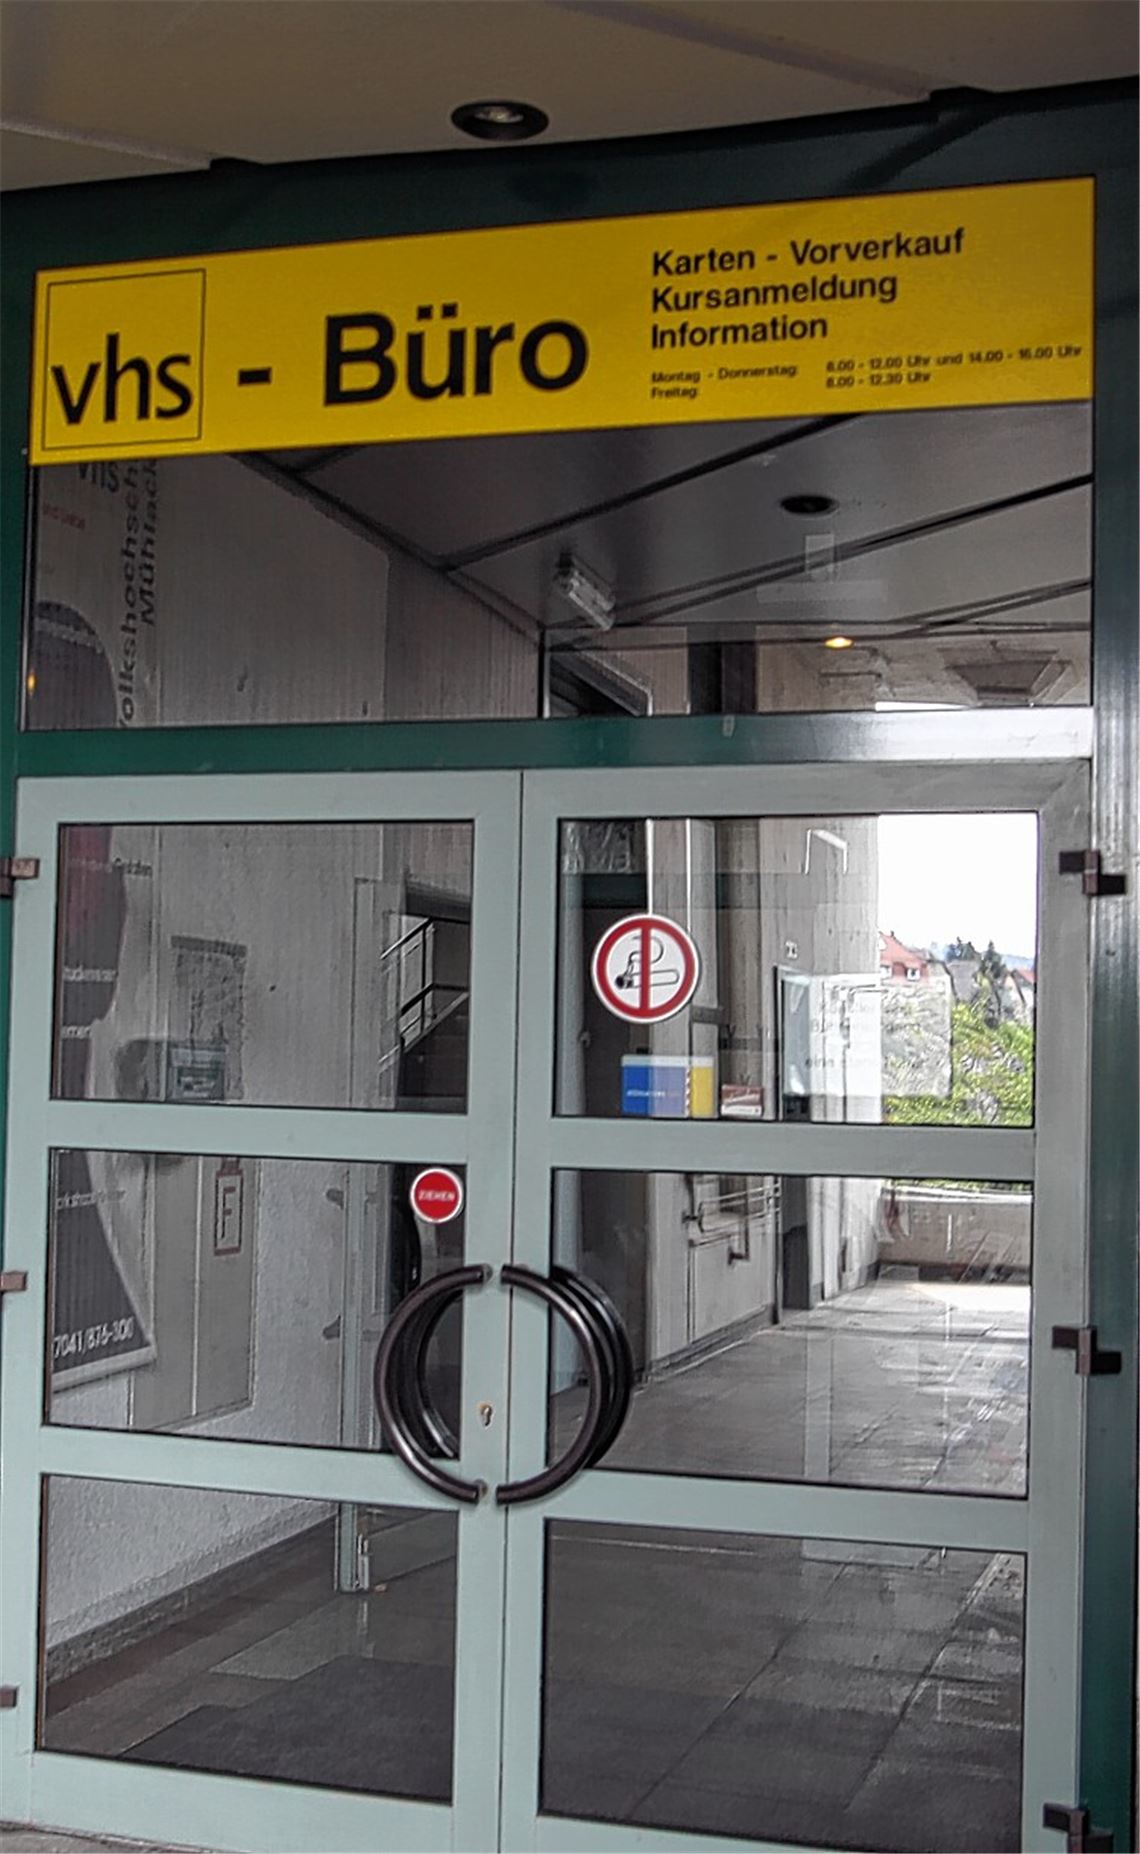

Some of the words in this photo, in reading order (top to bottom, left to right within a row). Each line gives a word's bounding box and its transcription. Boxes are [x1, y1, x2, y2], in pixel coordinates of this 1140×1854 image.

[653, 249, 754, 276] Karten
[791, 228, 964, 265] Vorverkauf
[653, 272, 897, 312] Kursanmeldung
[652, 315, 827, 349] Information
[52, 333, 192, 424] vhs
[239, 368, 271, 385] -
[325, 304, 588, 406] Büro
[651, 372, 700, 383] Montag
[718, 366, 797, 379] Donnerstag
[869, 356, 903, 370] 12.00
[907, 355, 930, 367] Uhr
[936, 353, 963, 366] und
[969, 350, 1003, 363] 14.00
[1019, 347, 1053, 359] 16.00
[1058, 346, 1082, 357] Uhr
[651, 387, 698, 399] Freitag
[869, 372, 903, 386] 12.30
[907, 372, 930, 383] Uhr
